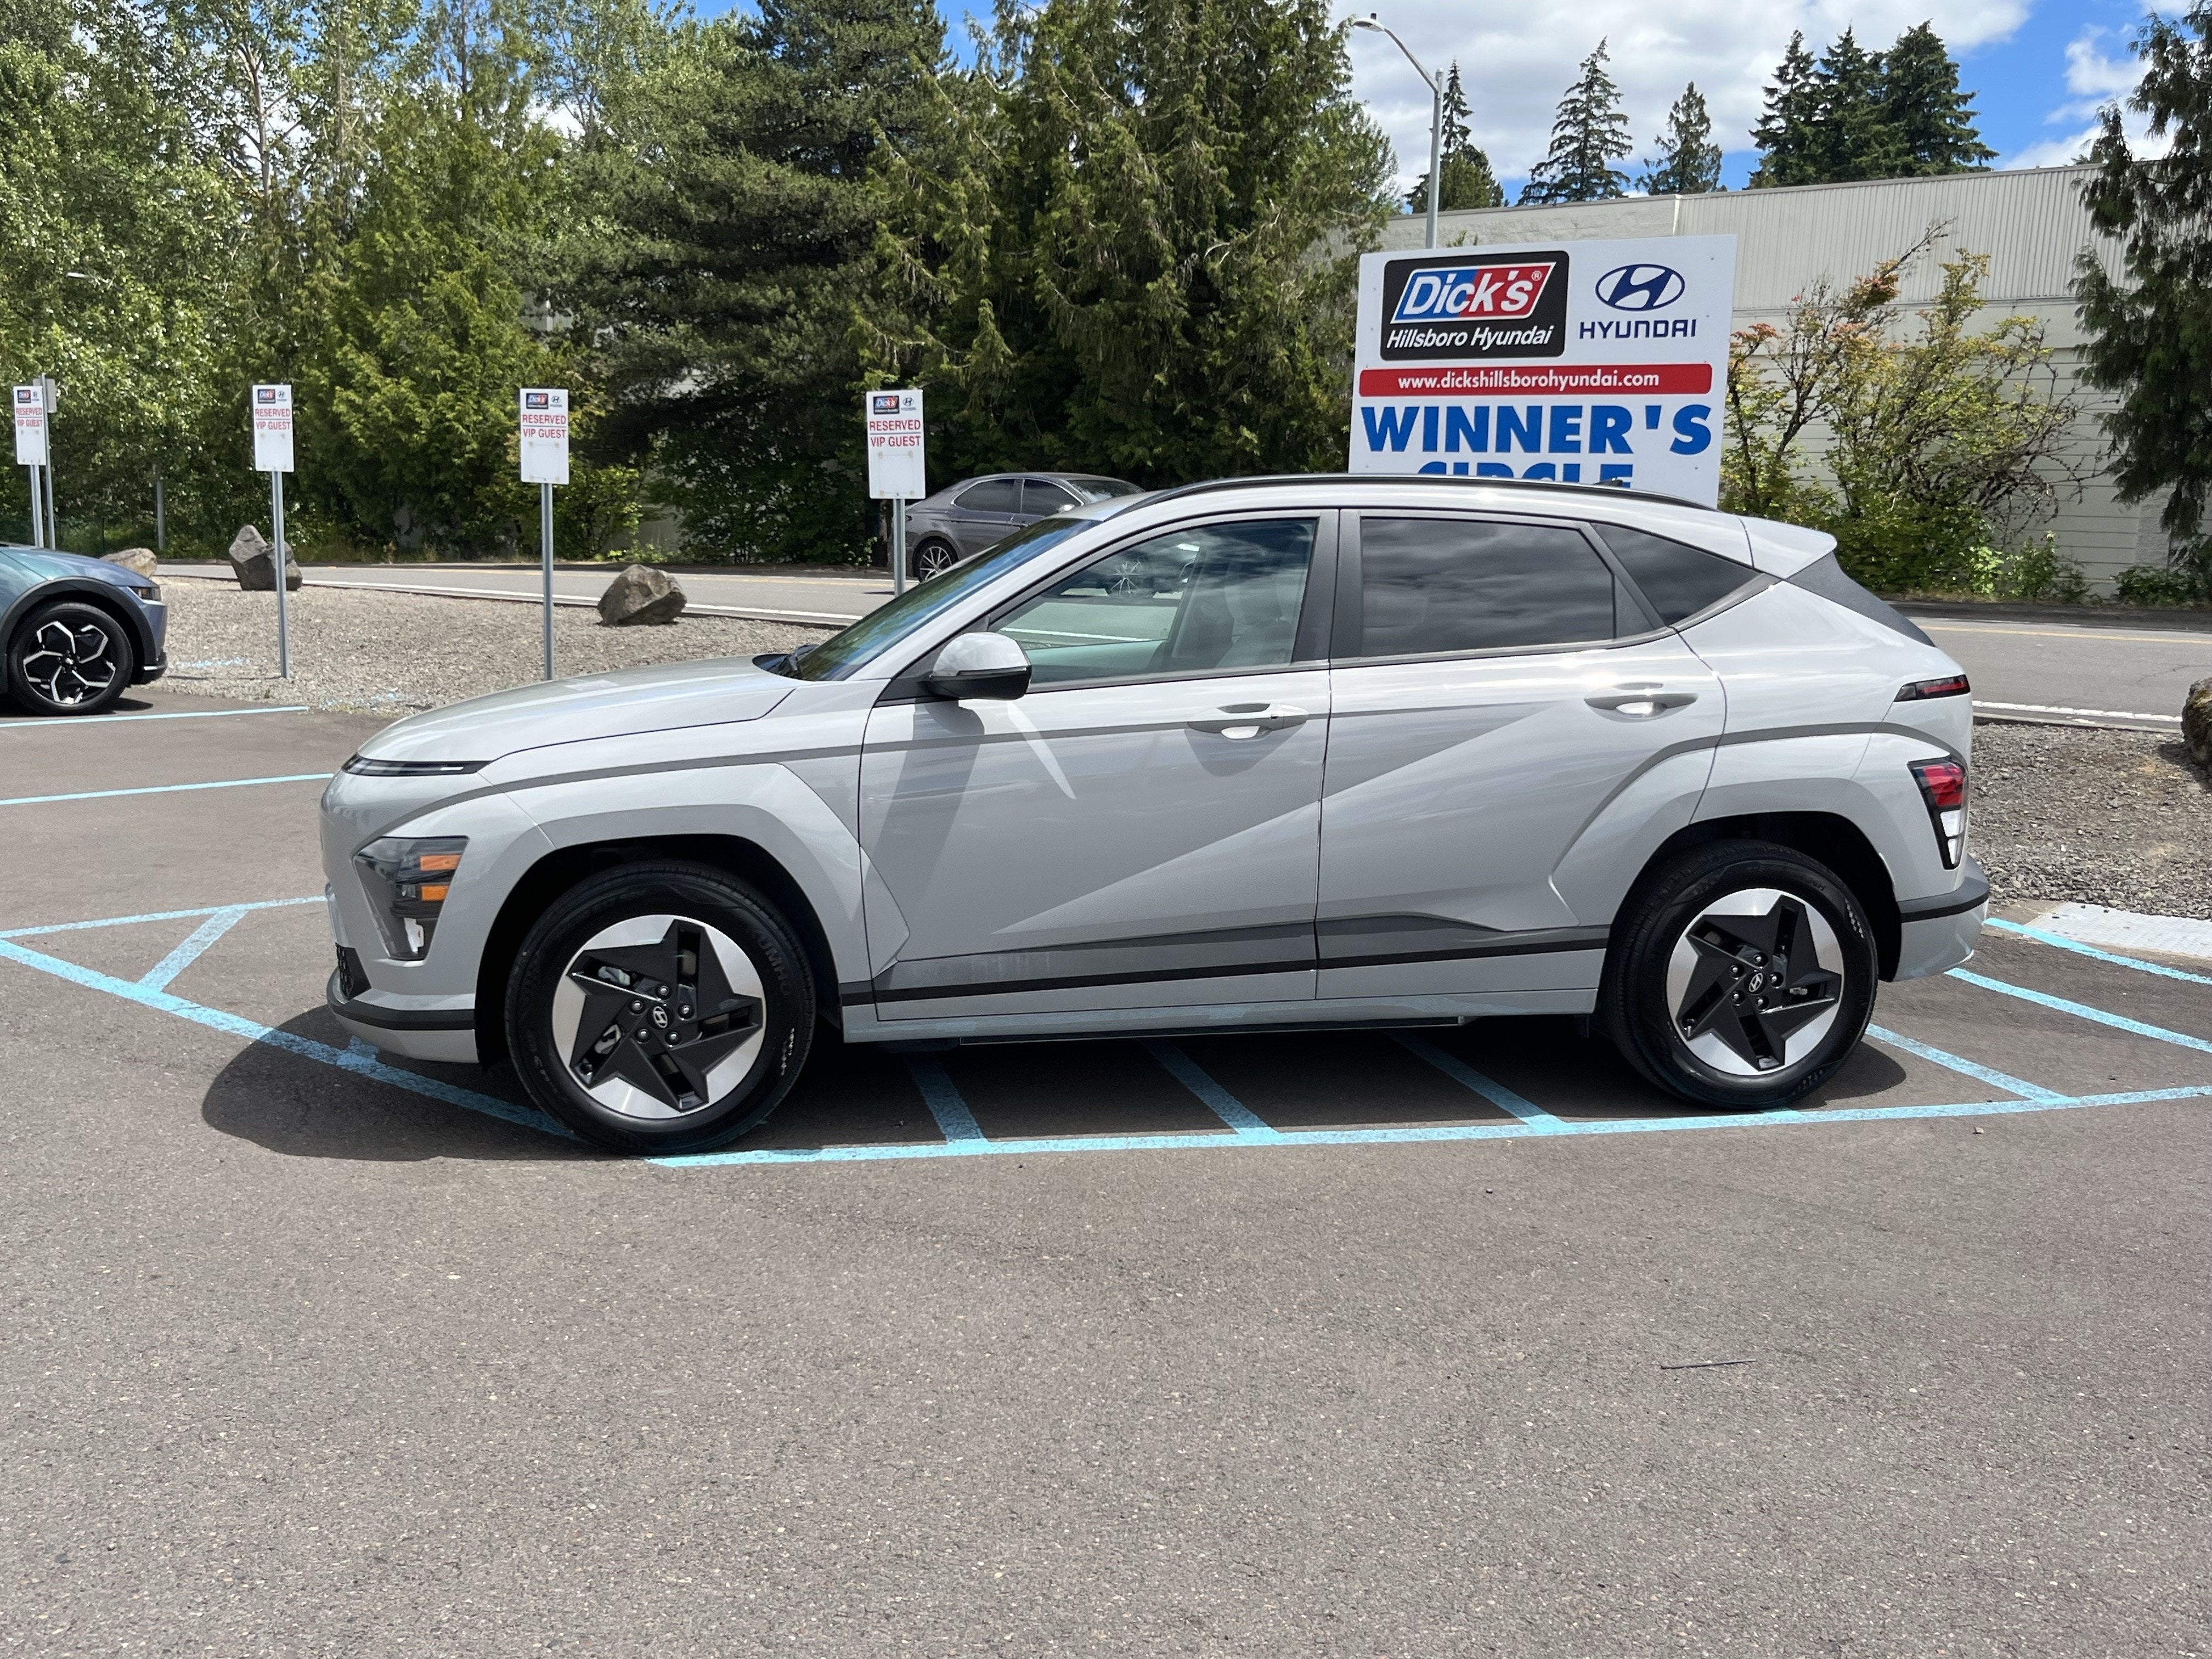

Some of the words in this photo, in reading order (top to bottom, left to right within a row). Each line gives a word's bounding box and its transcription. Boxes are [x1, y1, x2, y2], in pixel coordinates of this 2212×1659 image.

[1579, 319, 1697, 339] HYUNDAI
[1386, 328, 1468, 349] Hillsboro
[1470, 325, 1555, 351] Hyundai
[1398, 371, 1660, 391] www.dickshillsborohyundai.com
[255, 408, 291, 417] RESERVED
[522, 414, 566, 424] RESERVED
[256, 421, 266, 430] VIP
[268, 421, 291, 430] GUEST
[870, 420, 921, 431] RESERVED
[1361, 404, 1712, 455] WINNER'S
[523, 428, 536, 437] VIP
[538, 428, 566, 438] GUEST
[870, 437, 885, 447] VIP
[888, 436, 921, 447] GUEST
